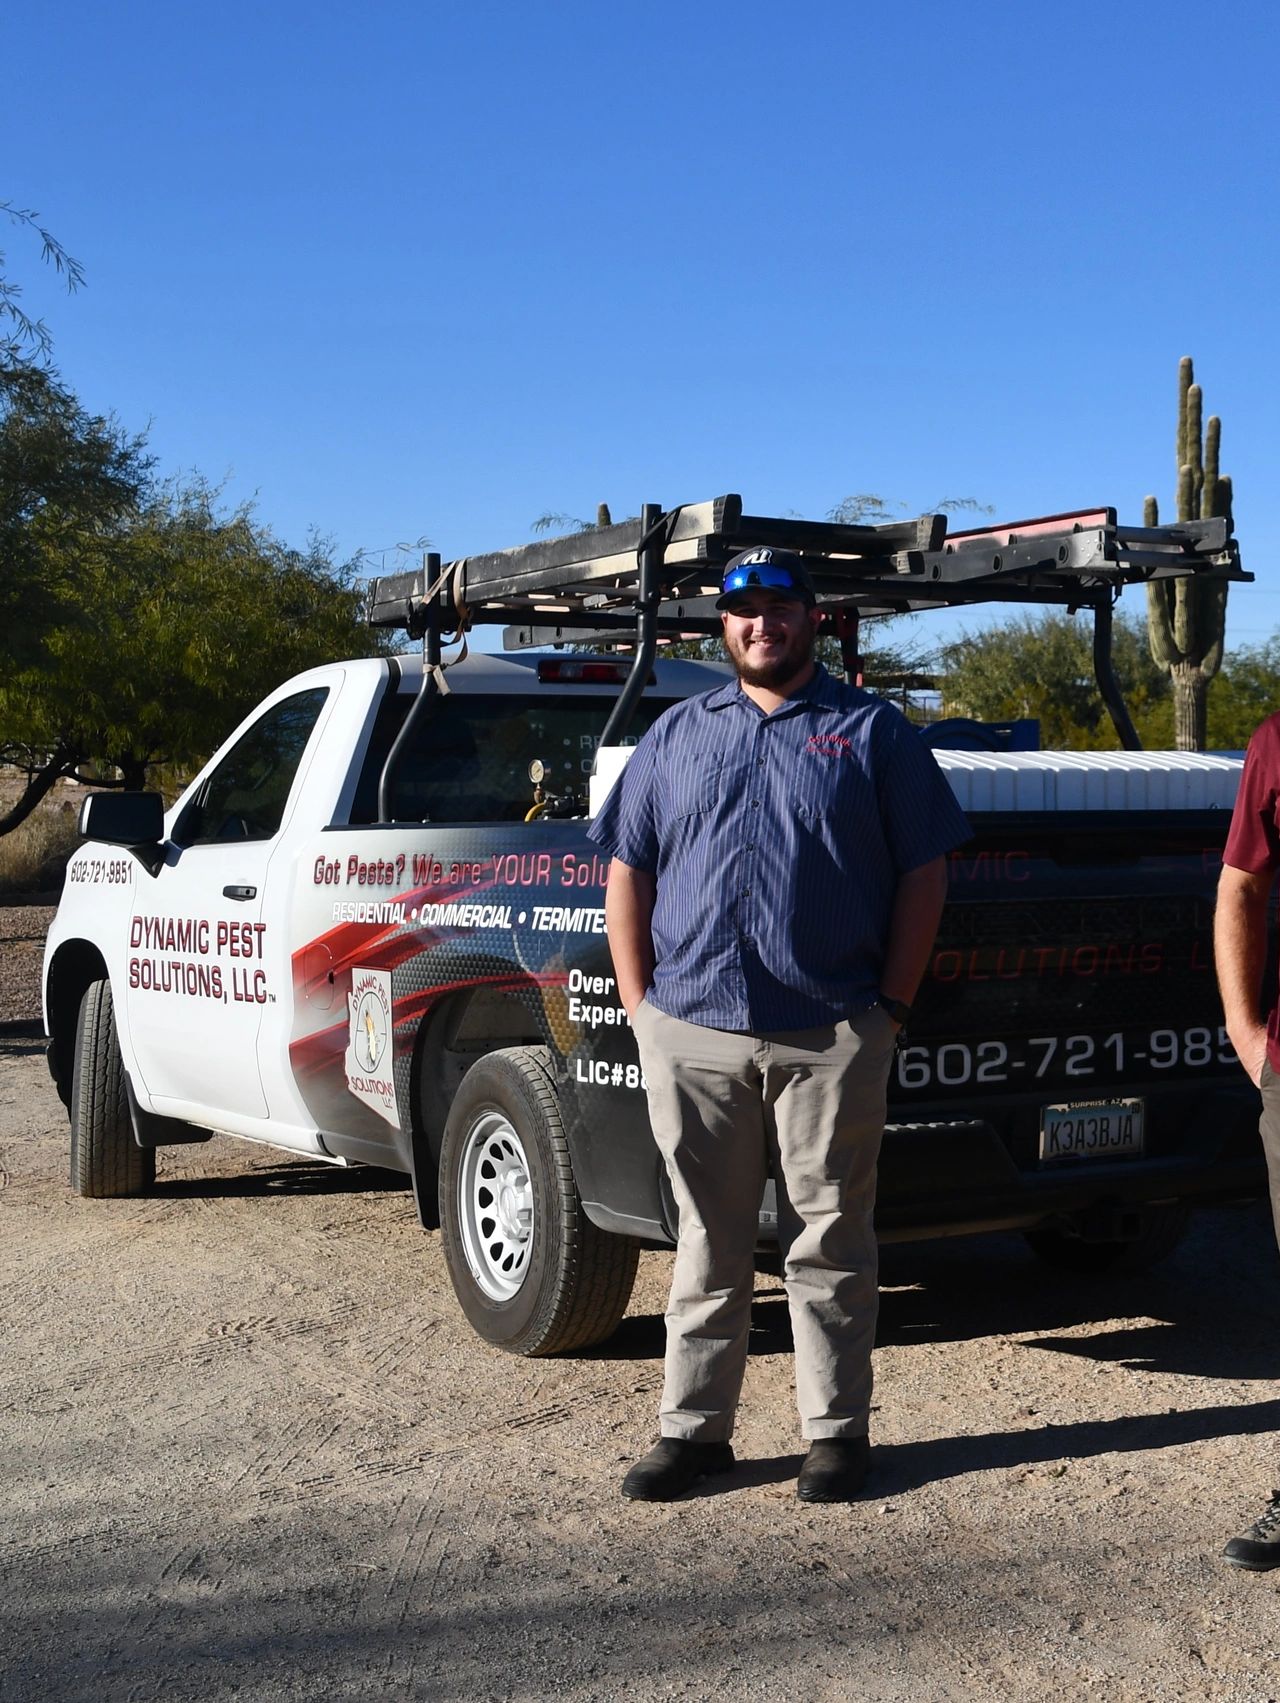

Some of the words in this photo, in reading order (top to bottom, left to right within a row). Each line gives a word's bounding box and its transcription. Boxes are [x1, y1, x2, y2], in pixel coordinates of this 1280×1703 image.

[70, 860, 134, 884] 602-721-9851
[313, 855, 341, 885] Got
[347, 853, 405, 886] Pests?
[413, 853, 441, 886] We
[450, 863, 481, 886] are
[492, 853, 551, 887] YOUR
[561, 853, 612, 888] Solu
[331, 902, 407, 925] RESIDENTIAL
[420, 903, 512, 929] COMMERCIAL
[130, 916, 209, 955] DYNAMIC
[217, 921, 267, 960] PEST
[933, 943, 1172, 984] OLUTIONS,
[129, 958, 228, 1005] SOLUTIONS,
[233, 968, 267, 1004] LLC
[352, 975, 378, 1012] DYNAMIC
[378, 983, 390, 1015] PEST
[568, 968, 615, 996] Over
[568, 997, 632, 1030] Experi
[576, 1058, 647, 1090] LIC#8
[897, 1026, 1238, 1089] 602-721-985
[351, 1076, 394, 1098] SOLUTIONS
[1050, 1114, 1133, 1152] K3A3BJA
